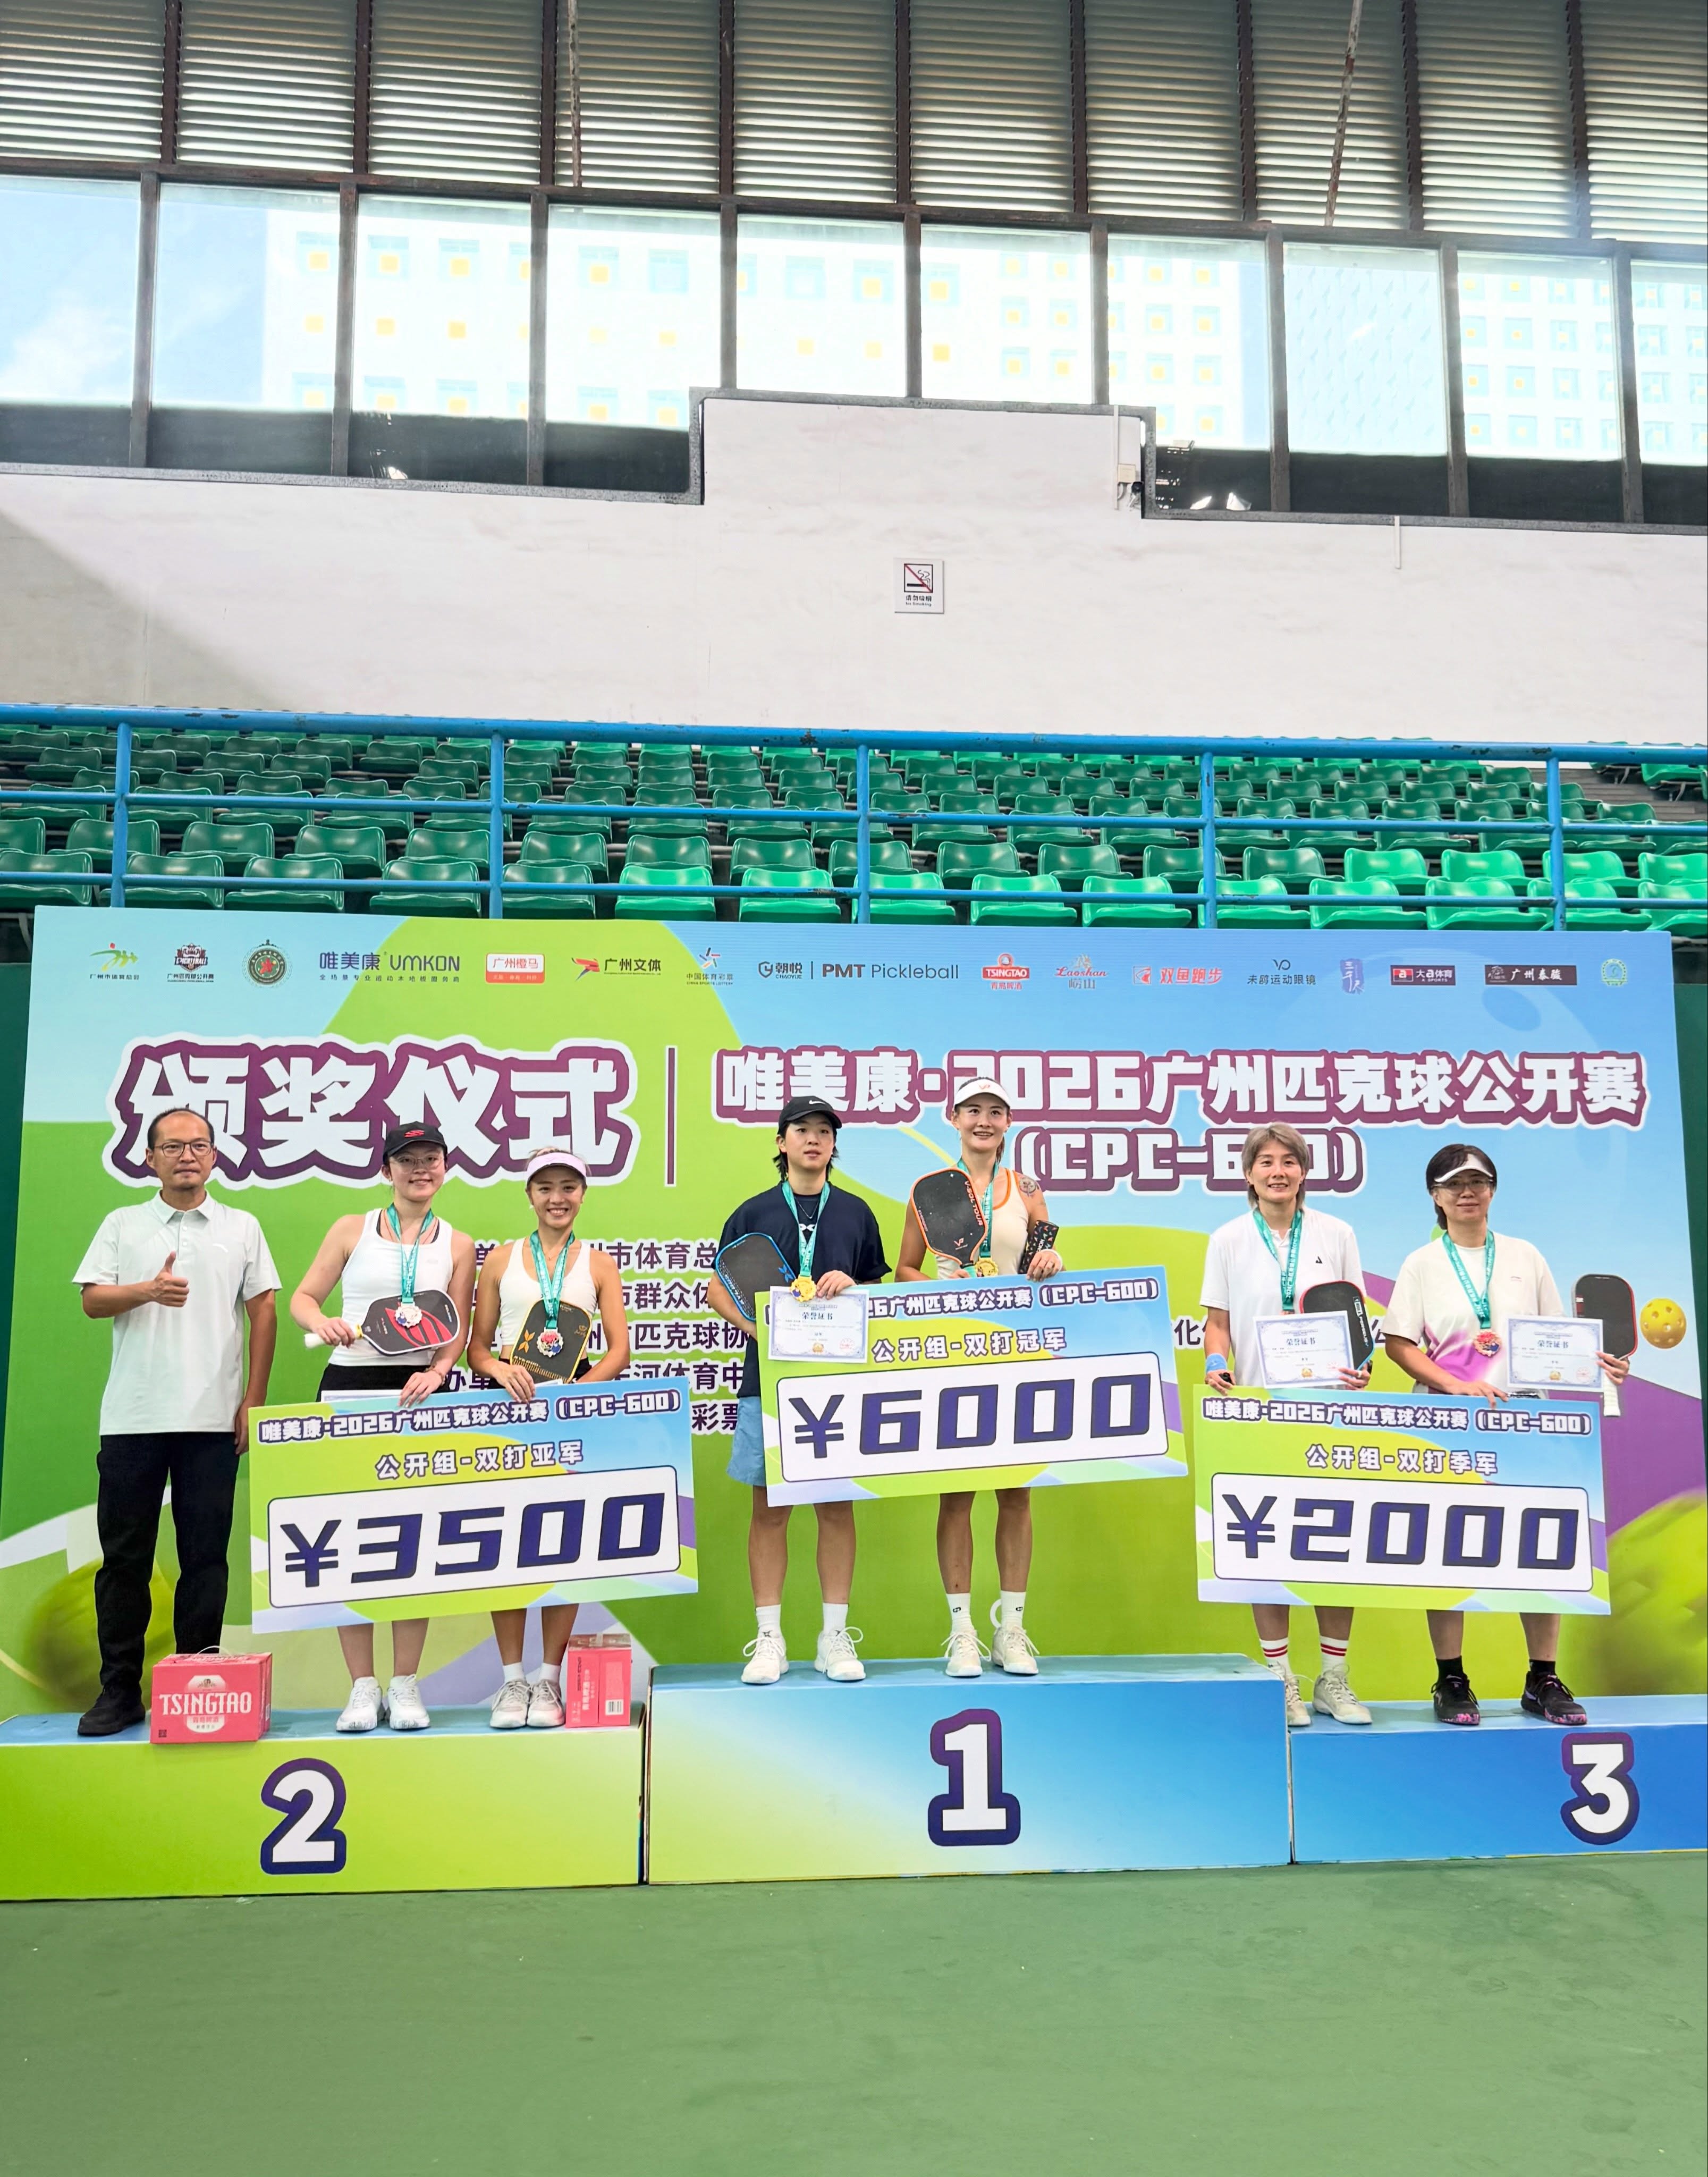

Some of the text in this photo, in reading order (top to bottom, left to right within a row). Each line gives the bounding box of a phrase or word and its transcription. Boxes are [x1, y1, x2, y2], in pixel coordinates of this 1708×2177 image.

[319, 951, 381, 971] 唯美康
[493, 958, 538, 969] 广州橙马
[604, 958, 661, 972] 广州文体
[822, 963, 958, 979] PMT Pickleball
[986, 968, 1027, 977] TSINGTAO
[1055, 966, 1109, 977] Laoshan
[1160, 967, 1222, 984] 双鱼跑步
[122, 1050, 621, 1171] 颁奖仪式
[973, 1204, 983, 1226] TOUR
[802, 1312, 833, 1320] 荣誉证书
[872, 1327, 1067, 1363] 公开组-双打冠军
[788, 1373, 1152, 1459] ¥6000
[375, 1439, 585, 1480] 公开组-双打亚军
[1305, 1444, 1498, 1475] 公开组-双打季军
[280, 1492, 665, 1588] ¥3500
[1221, 1493, 1579, 1571] ¥2000
[159, 1691, 252, 1716] TSINGTAO
[936, 1717, 1013, 1838] 1
[1566, 1738, 1634, 1839] 3
[267, 1764, 341, 1869] 2
